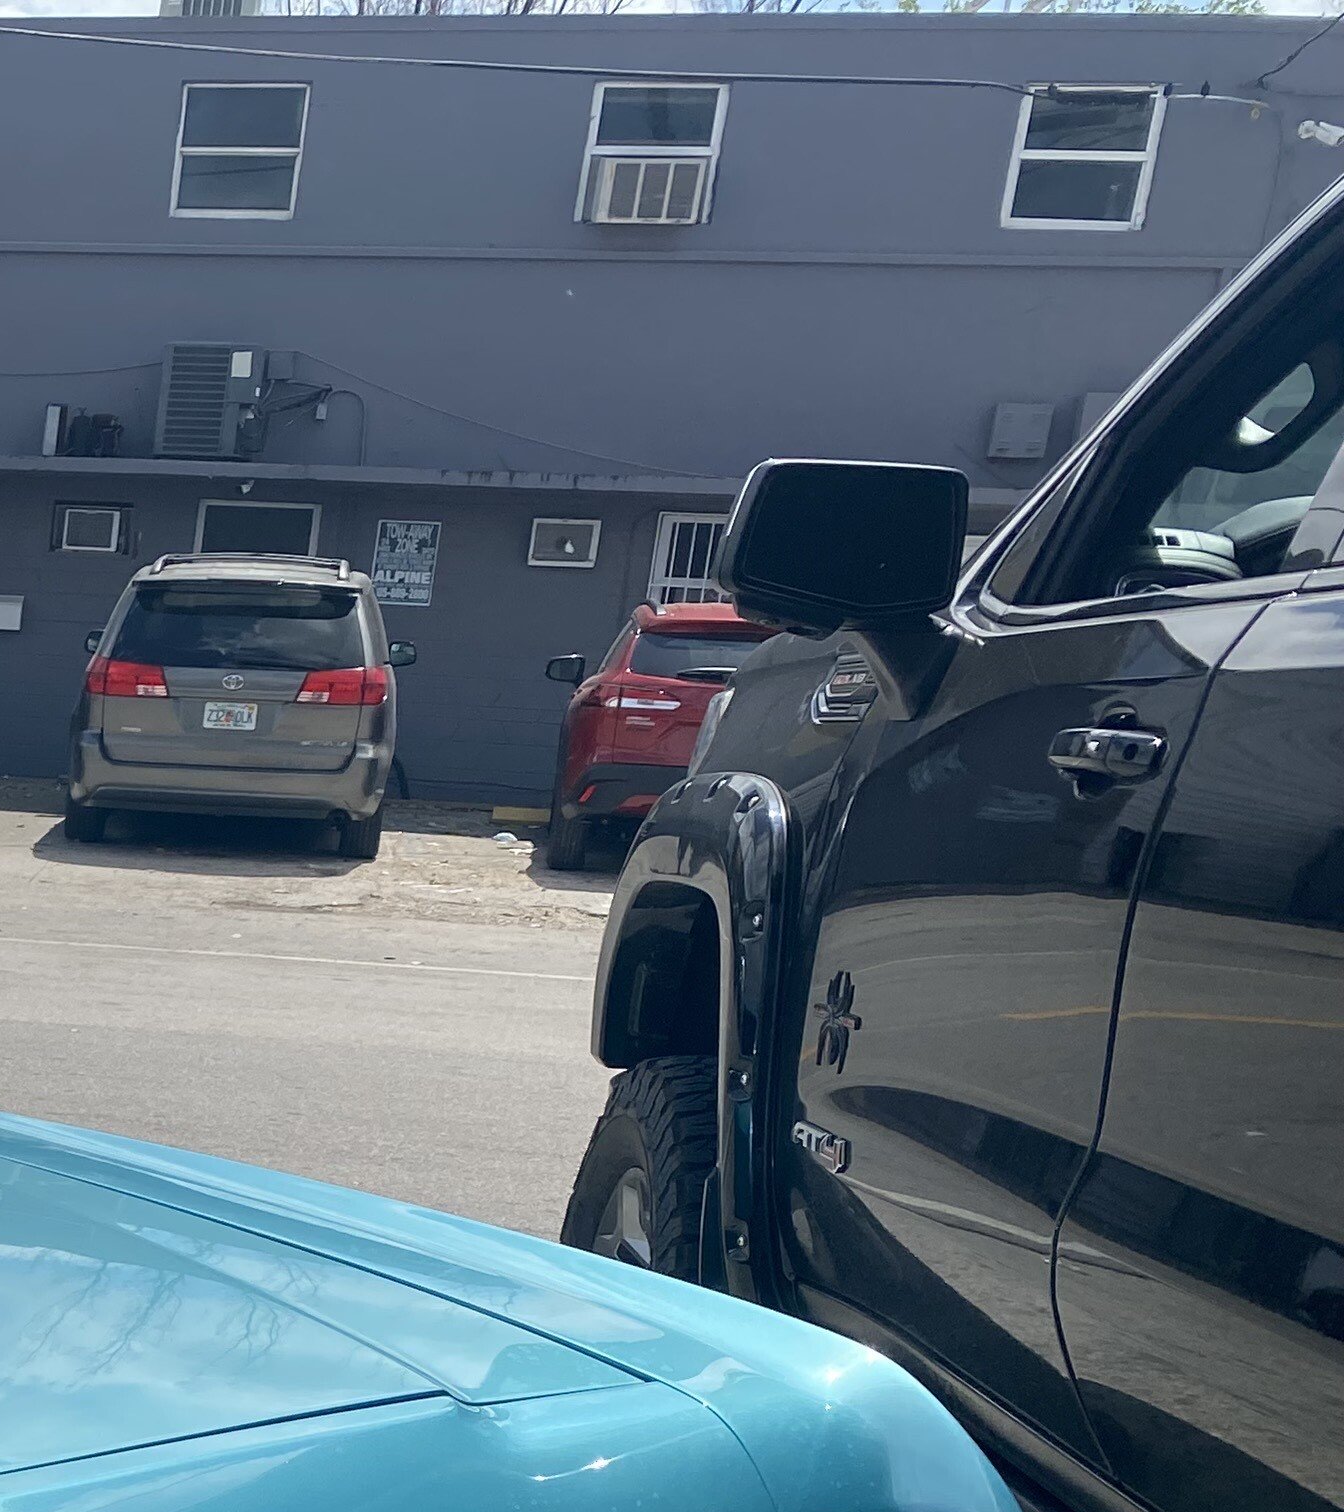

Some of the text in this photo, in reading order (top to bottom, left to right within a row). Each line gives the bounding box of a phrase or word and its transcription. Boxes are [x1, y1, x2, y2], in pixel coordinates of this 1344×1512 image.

[386, 523, 434, 540] TOW-AWAY
[395, 538, 420, 554] ZONE
[374, 569, 432, 584] ALPINE
